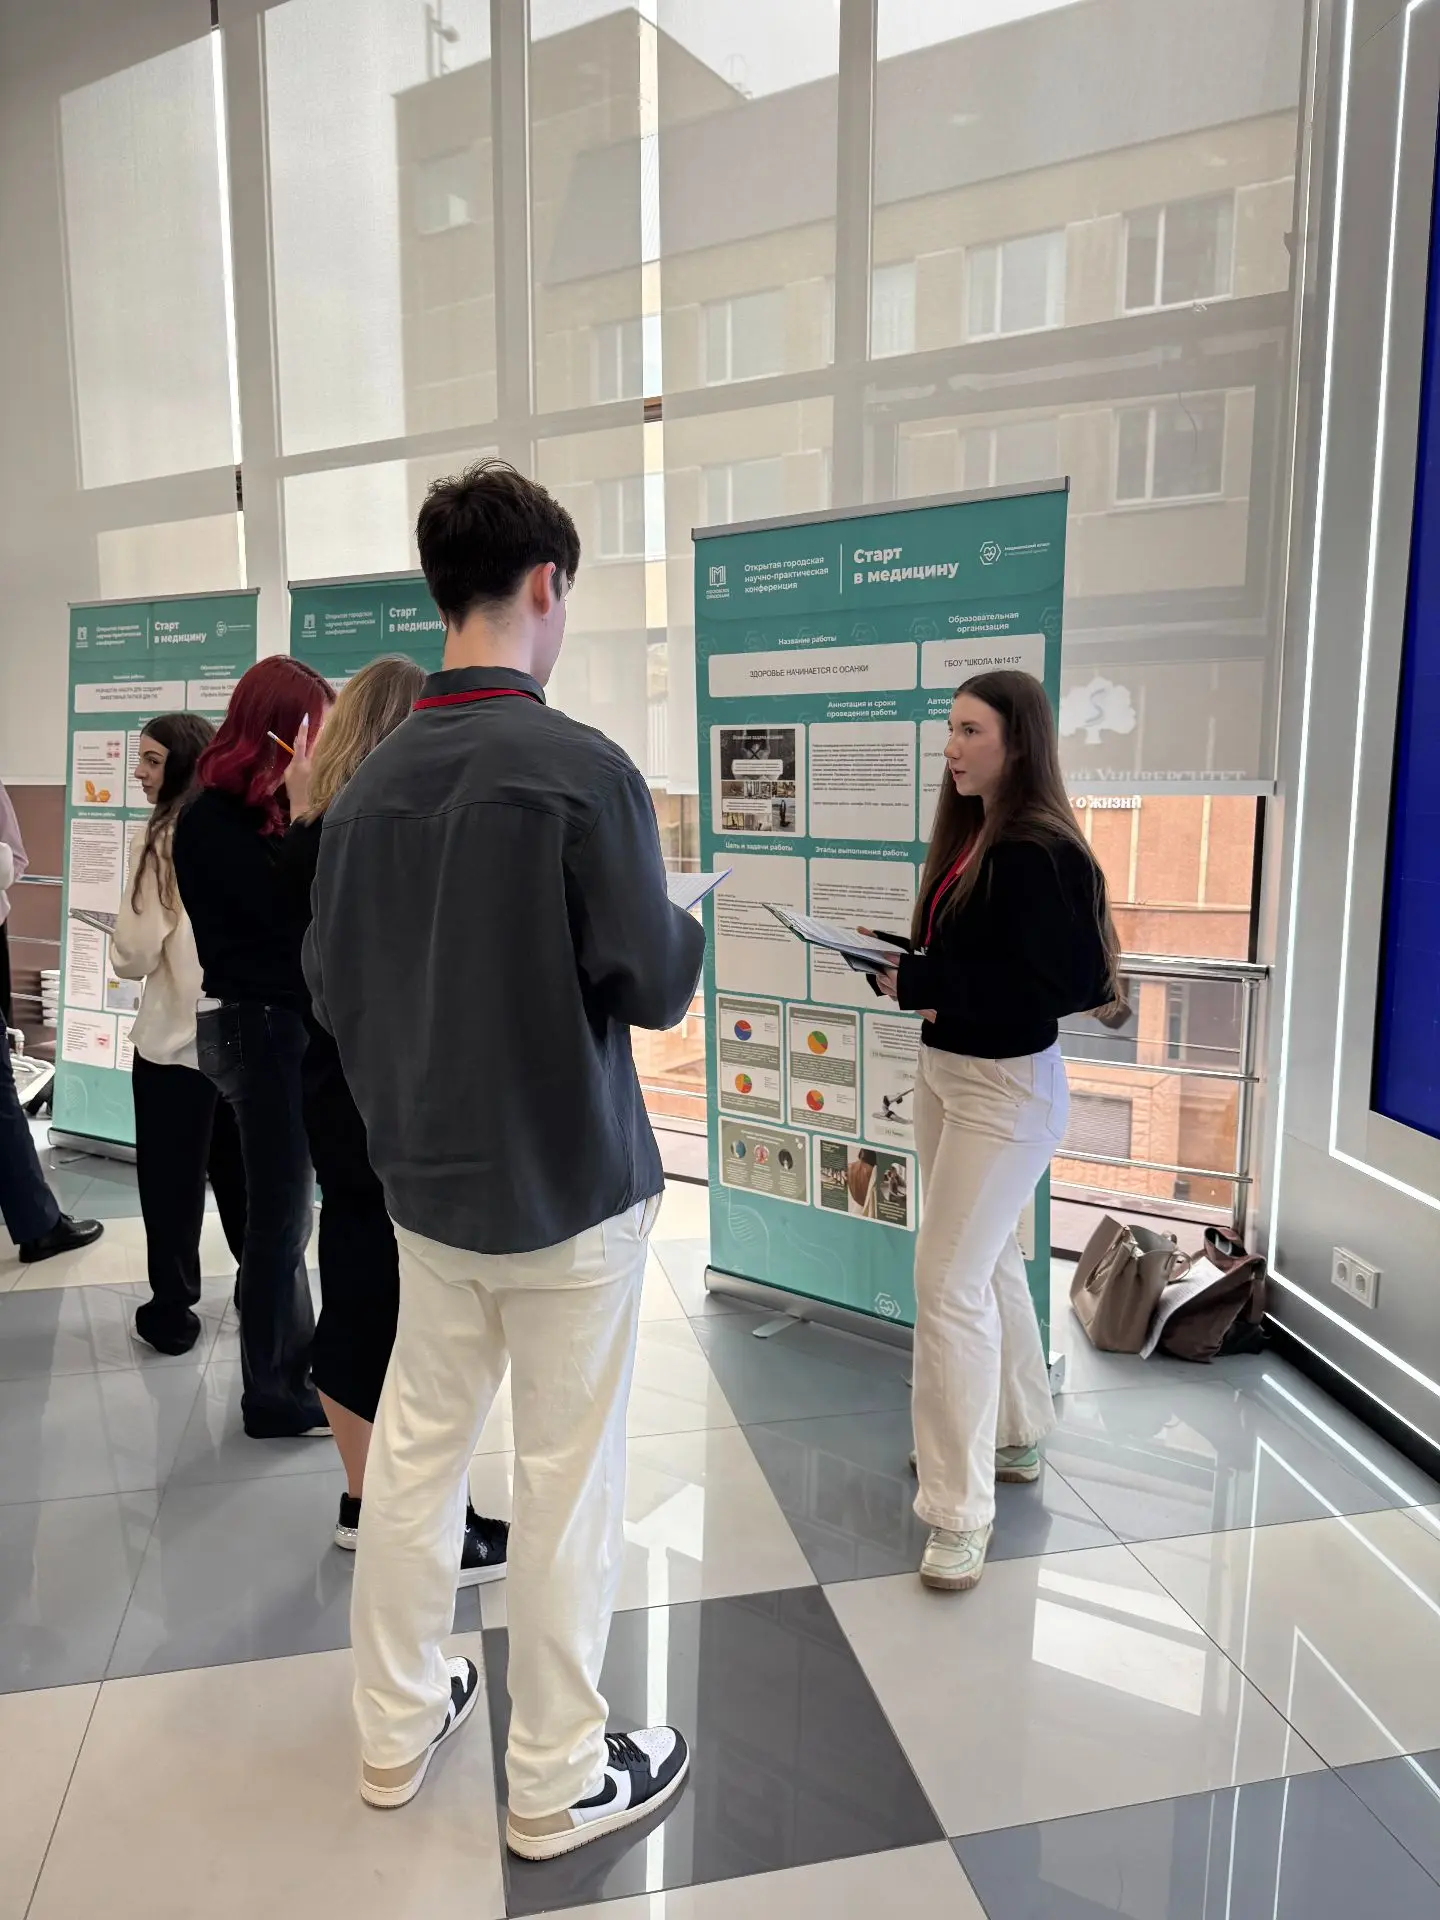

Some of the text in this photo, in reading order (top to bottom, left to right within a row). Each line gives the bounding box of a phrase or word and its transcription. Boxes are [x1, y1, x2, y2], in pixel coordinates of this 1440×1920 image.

[853, 547, 902, 564] Старт
[744, 556, 825, 573] Открытая городская
[744, 567, 829, 583] научно-практическая
[853, 562, 959, 584] в медицину
[744, 581, 798, 593] конференция
[388, 607, 417, 618] Старт
[948, 612, 1019, 624] Образовательная
[154, 621, 180, 632] Старт
[956, 623, 1010, 633] организация
[160, 632, 207, 644] медицину
[811, 635, 837, 644] работы
[944, 659, 963, 667] ГБОУ
[750, 664, 869, 678] ЗДОРОВЬЕ НАЧИНАЕТСЯ С ОСАНКИ
[827, 701, 866, 709] Аннотация
[873, 700, 896, 708] сроки
[826, 708, 897, 718] проведения работы
[769, 844, 793, 852] работы
[882, 849, 909, 858] работы
